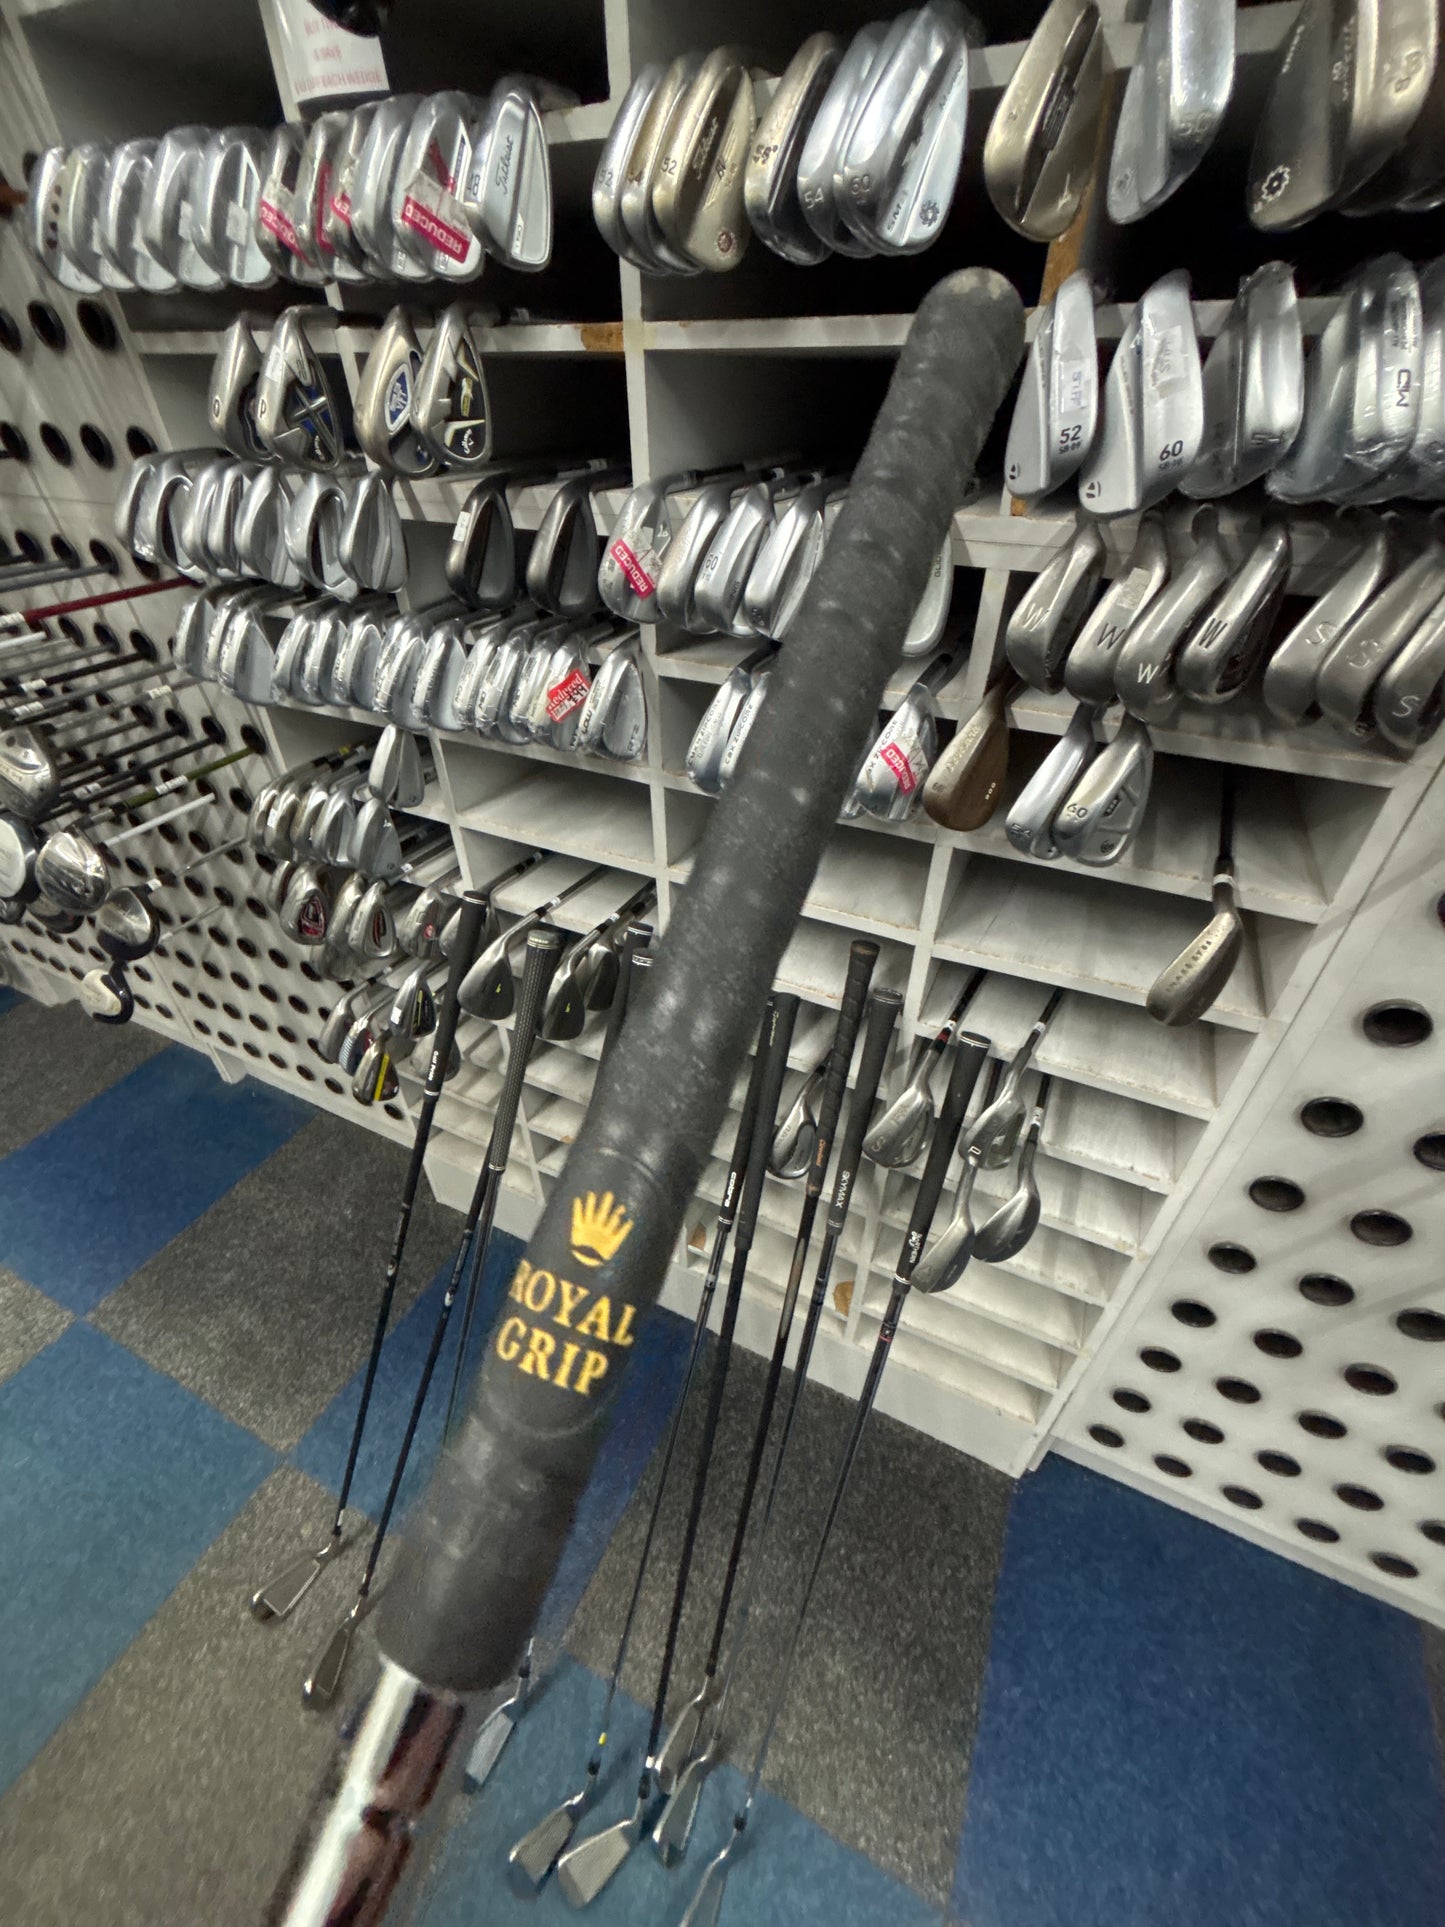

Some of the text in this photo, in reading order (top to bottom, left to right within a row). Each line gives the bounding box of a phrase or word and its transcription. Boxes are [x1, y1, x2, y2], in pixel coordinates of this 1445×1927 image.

[661, 156, 678, 176] 52
[804, 186, 825, 209] 54
[404, 202, 464, 256] REDUCED
[1396, 367, 1411, 408] MID
[1059, 424, 1082, 445] 52
[1159, 440, 1184, 461] 60
[614, 545, 648, 593] REDUCED
[1022, 602, 1051, 632] W
[1097, 622, 1126, 650] W
[1198, 617, 1229, 649] W
[1305, 621, 1338, 645] S
[1137, 662, 1159, 685] W
[1392, 695, 1421, 718] S
[581, 709, 593, 735] LOW
[1066, 802, 1089, 819] 60
[723, 1171, 737, 1208] cobra
[835, 1170, 850, 1209] SKYMAX
[509, 1258, 636, 1347] ROYAL
[496, 1316, 608, 1395] GRIP
